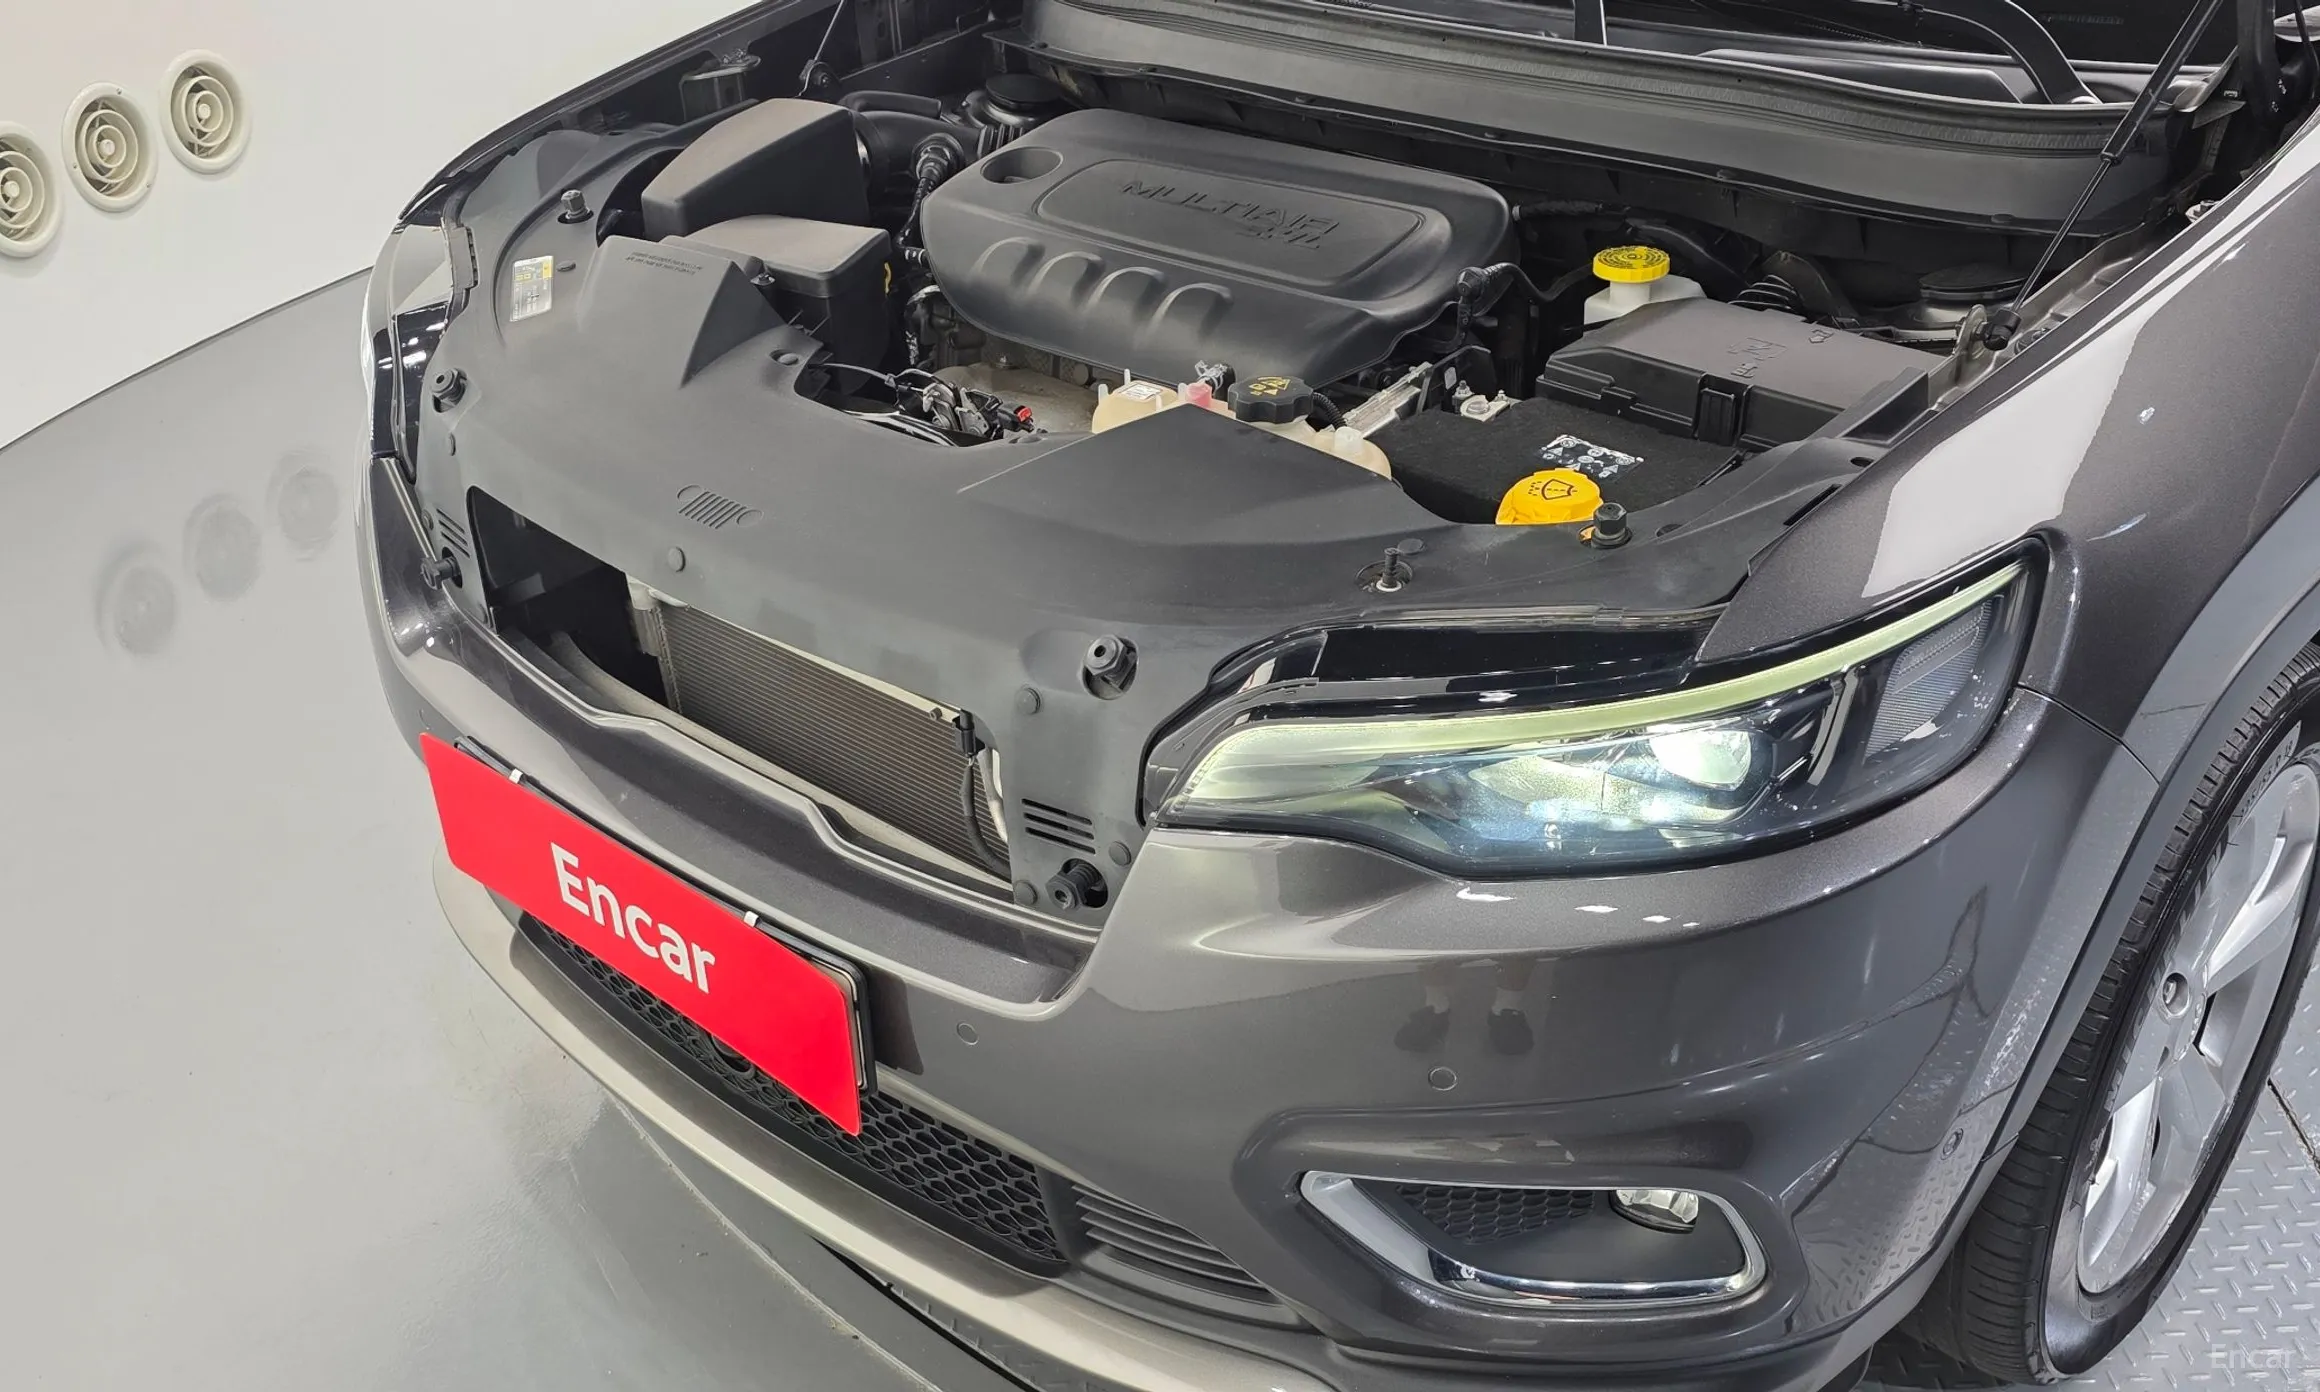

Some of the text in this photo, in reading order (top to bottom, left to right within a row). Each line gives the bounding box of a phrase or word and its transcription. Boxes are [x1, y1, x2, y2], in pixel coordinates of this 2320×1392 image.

[1119, 180, 1340, 235] MULTIAIR
[550, 841, 716, 995] Encar
[2103, 841, 2222, 1113] MICHELIN
